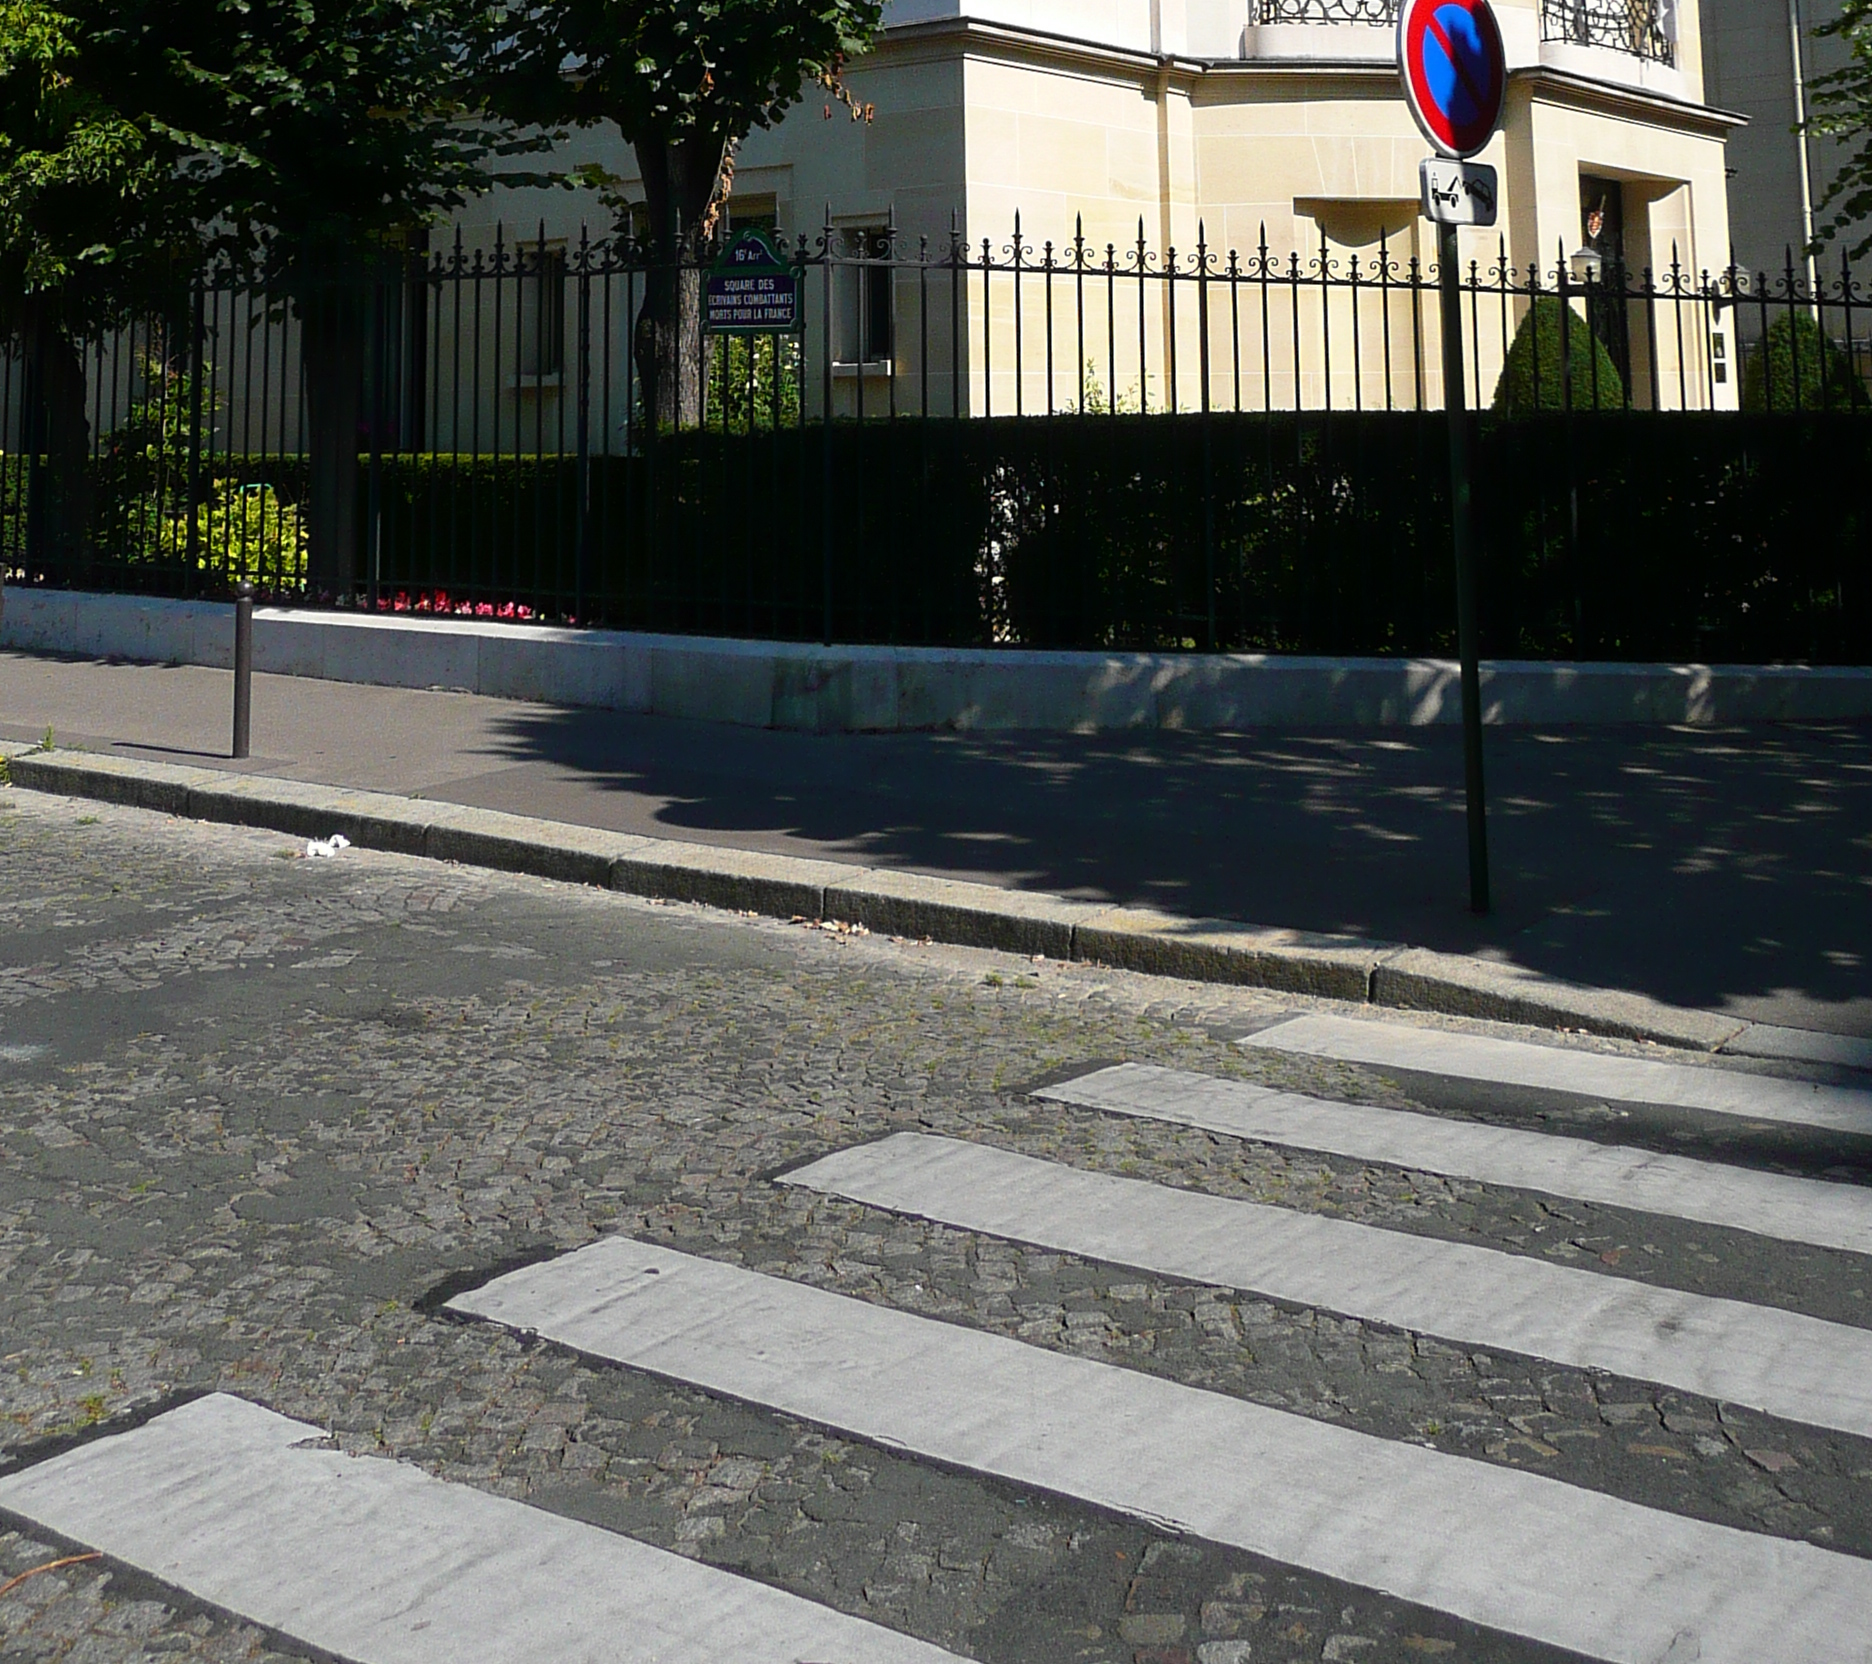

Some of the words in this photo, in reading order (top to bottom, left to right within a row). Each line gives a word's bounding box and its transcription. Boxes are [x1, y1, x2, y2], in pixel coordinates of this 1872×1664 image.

[724, 279, 755, 292] SQUARE
[758, 279, 774, 290] DES
[743, 293, 793, 304] COMBATTANTS
[709, 309, 731, 320] MORTS
[733, 308, 752, 319] POUR
[754, 308, 762, 319] LA
[764, 308, 792, 319] FRANCE
